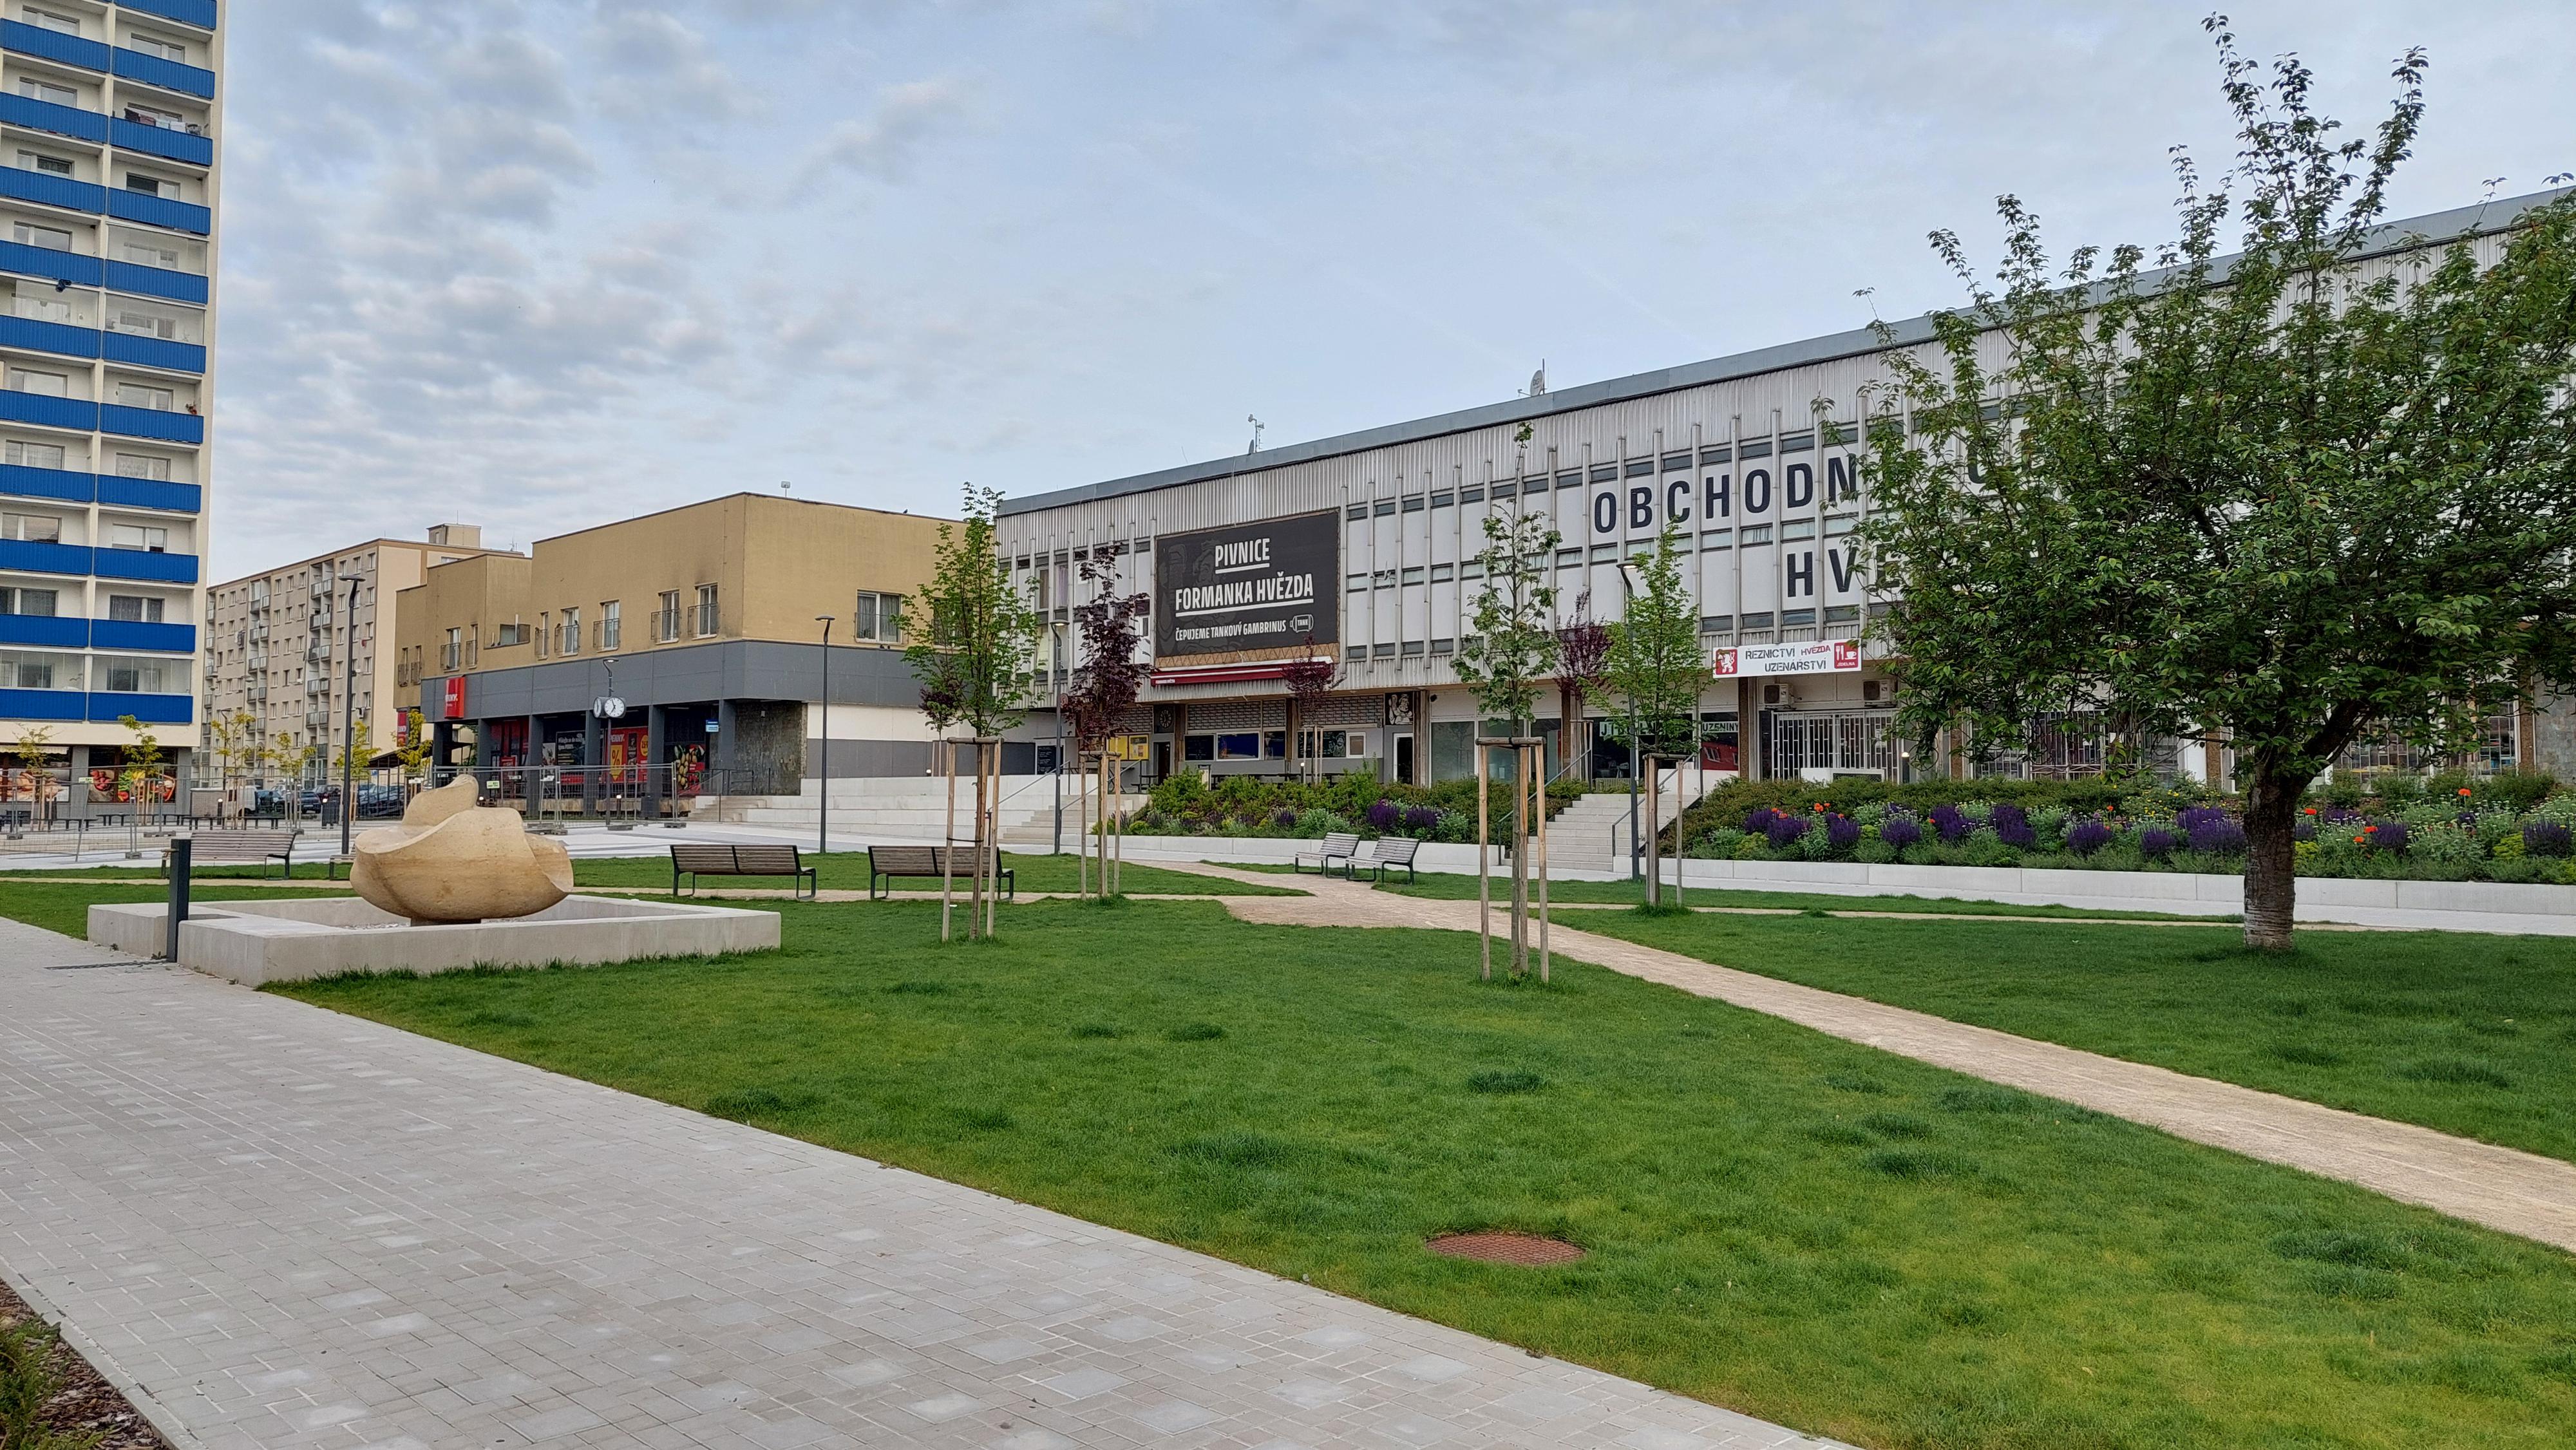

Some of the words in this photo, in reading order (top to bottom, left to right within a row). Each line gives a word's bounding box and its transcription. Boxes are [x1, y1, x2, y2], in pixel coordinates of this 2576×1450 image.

[1594, 457, 1857, 533] OBCHODN
[1215, 538, 1270, 567] PIVNICE
[1175, 581, 1253, 610] FORMANKA
[1256, 571, 1313, 602] HVĚZDA
[1175, 627, 1210, 641] ČEPUJEME
[1211, 621, 1242, 639] TANKOVÝ
[1243, 620, 1287, 636] GAMBRINUS
[1745, 646, 1795, 660] ŘEZNICTVÍ
[1765, 657, 1826, 672] UZENÁŘSTVÍ
[1702, 722, 1739, 732] UZENINY
